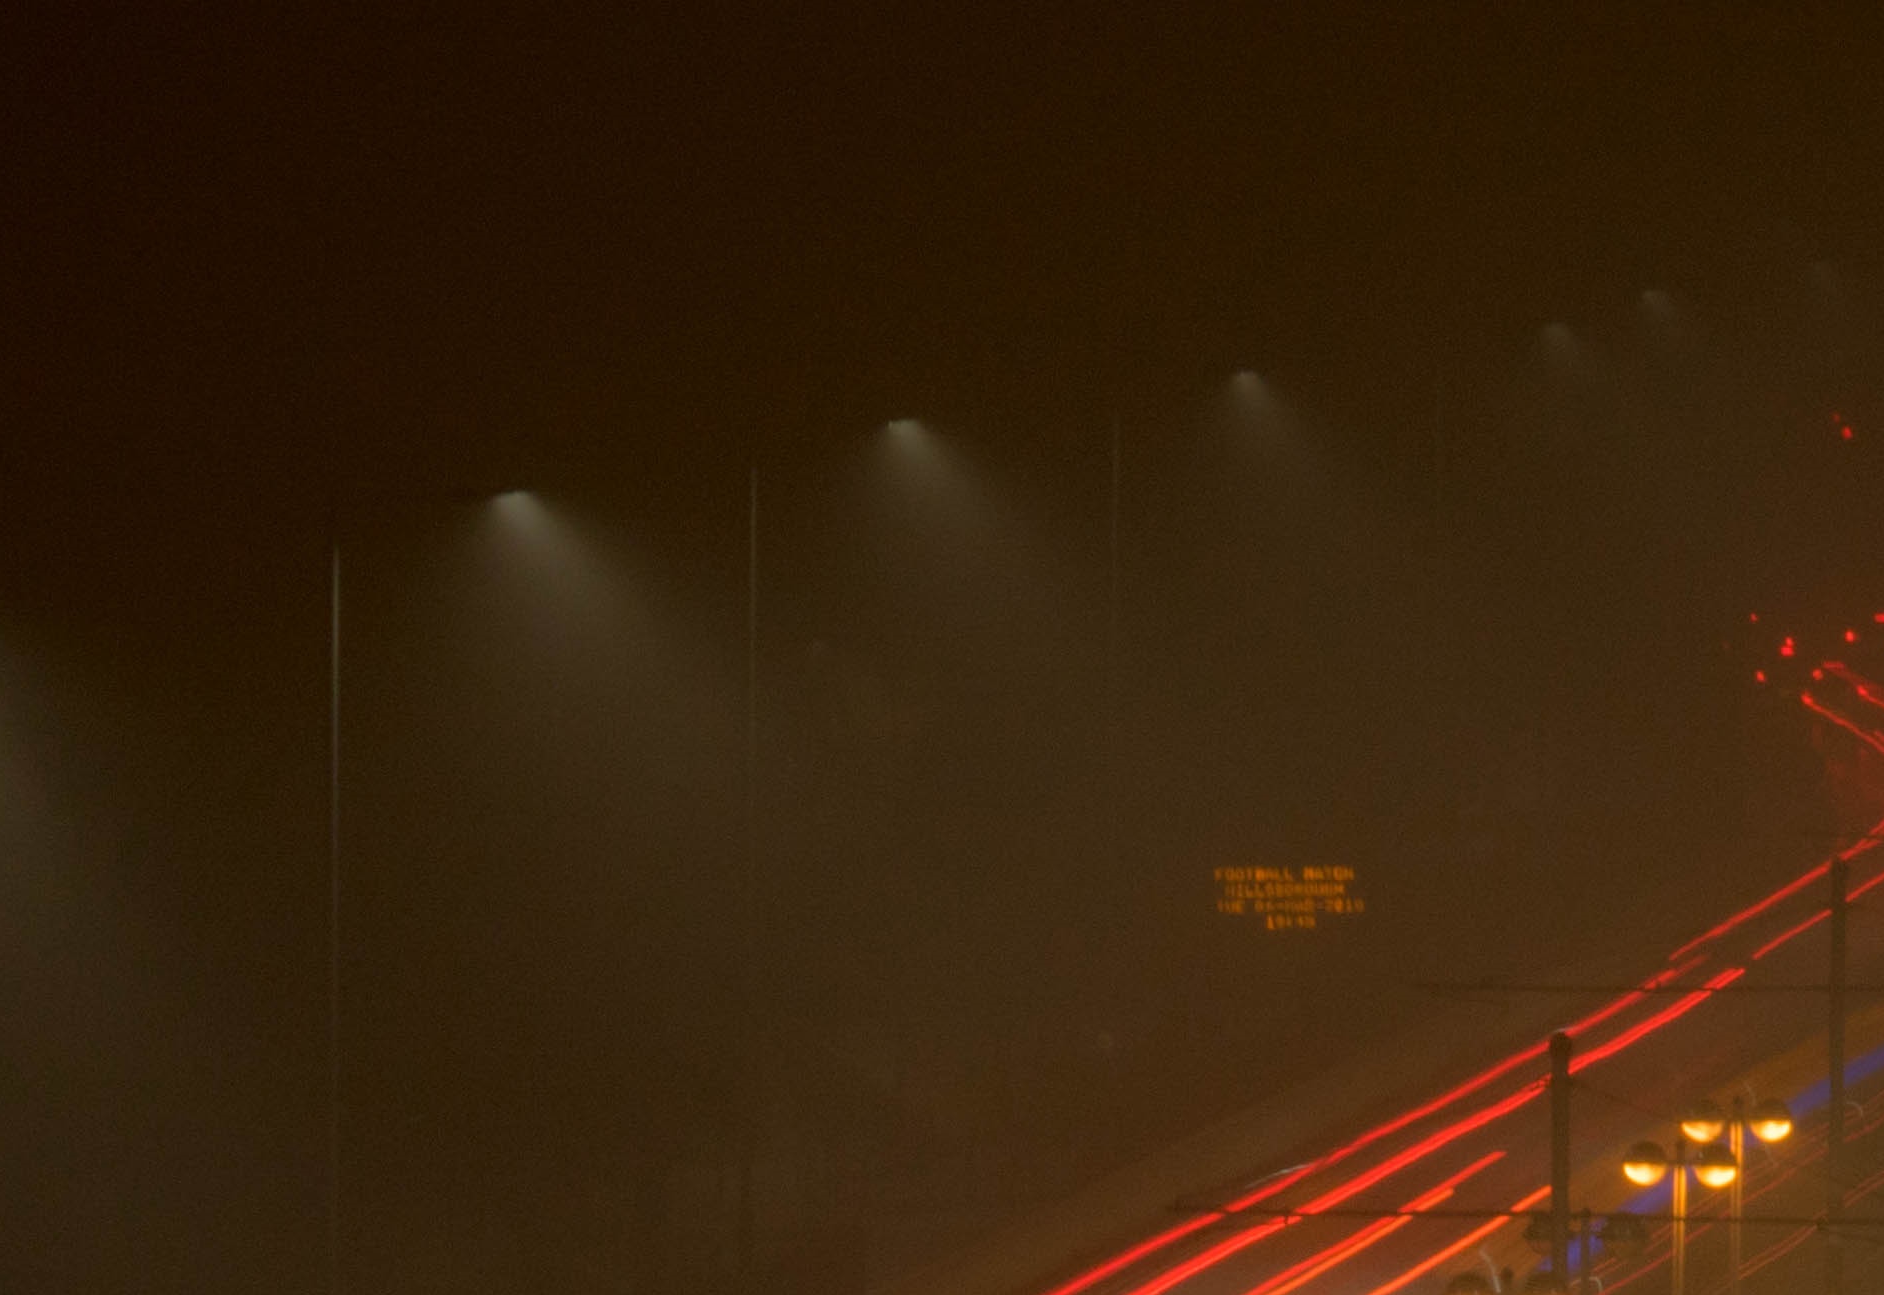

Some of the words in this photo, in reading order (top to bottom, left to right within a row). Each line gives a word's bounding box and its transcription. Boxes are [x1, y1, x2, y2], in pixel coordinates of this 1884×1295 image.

[1213, 866, 1294, 881] FOOTBALL
[1302, 864, 1355, 881] MATCH
[1224, 881, 1346, 897] HILLSBOROUGH
